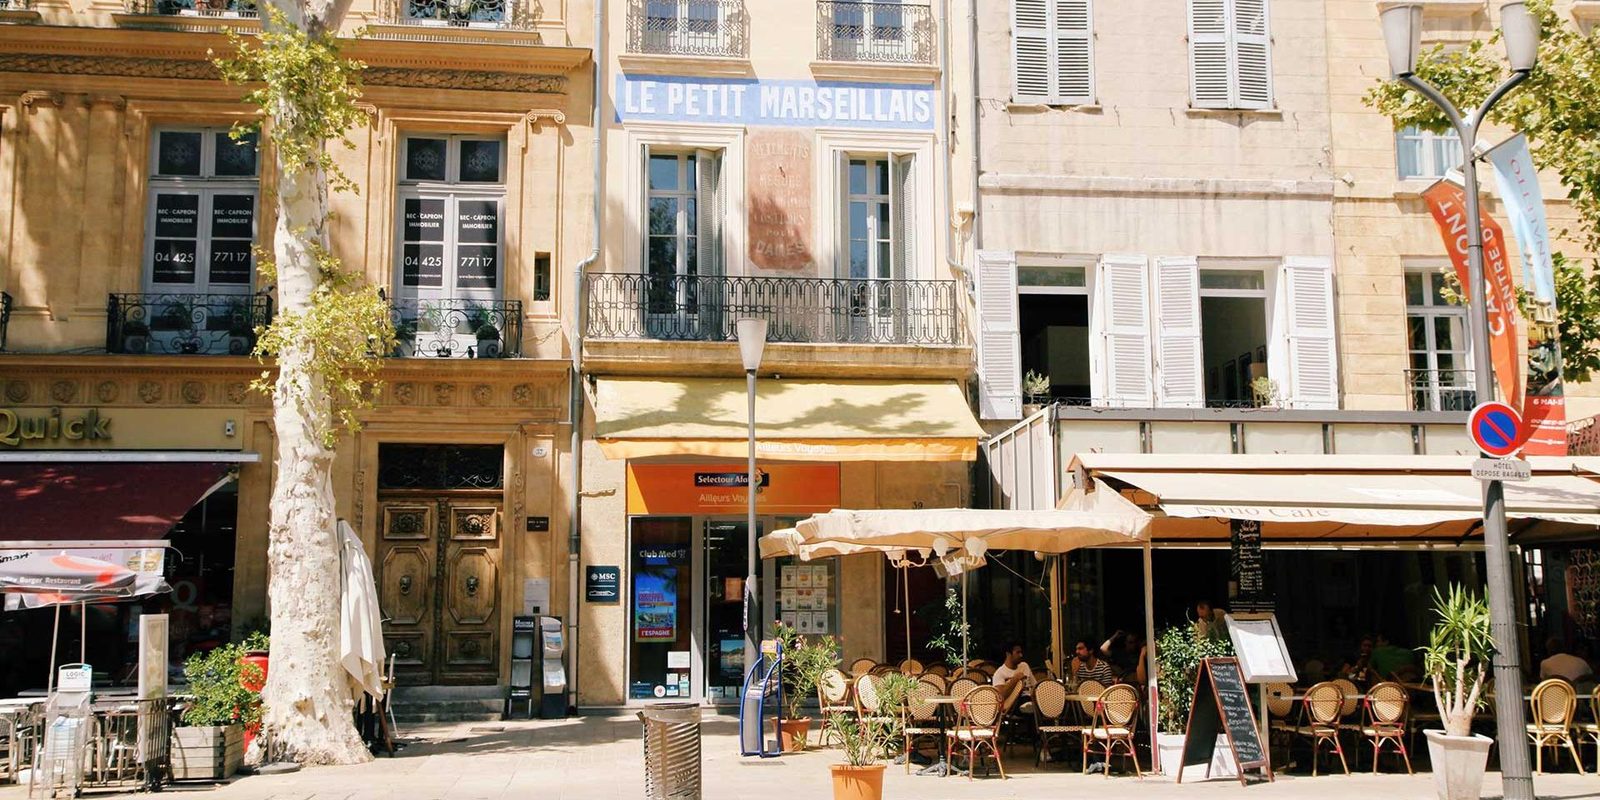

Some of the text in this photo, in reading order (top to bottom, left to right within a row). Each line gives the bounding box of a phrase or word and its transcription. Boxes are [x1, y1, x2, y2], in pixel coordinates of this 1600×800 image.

[625, 81, 930, 123] LE PETIT MARSEILLAIS
[155, 252, 194, 263] 04 425
[214, 252, 248, 263] 771 17
[404, 256, 442, 267] 04 425
[461, 257, 493, 267] 771 17
[1489, 246, 1517, 326] CENTRE
[698, 474, 734, 484] Selectour
[699, 493, 731, 504] Ailleurs
[639, 549, 677, 558] Club Med
[20, 576, 43, 585] Burger
[45, 576, 81, 585] Restaurant
